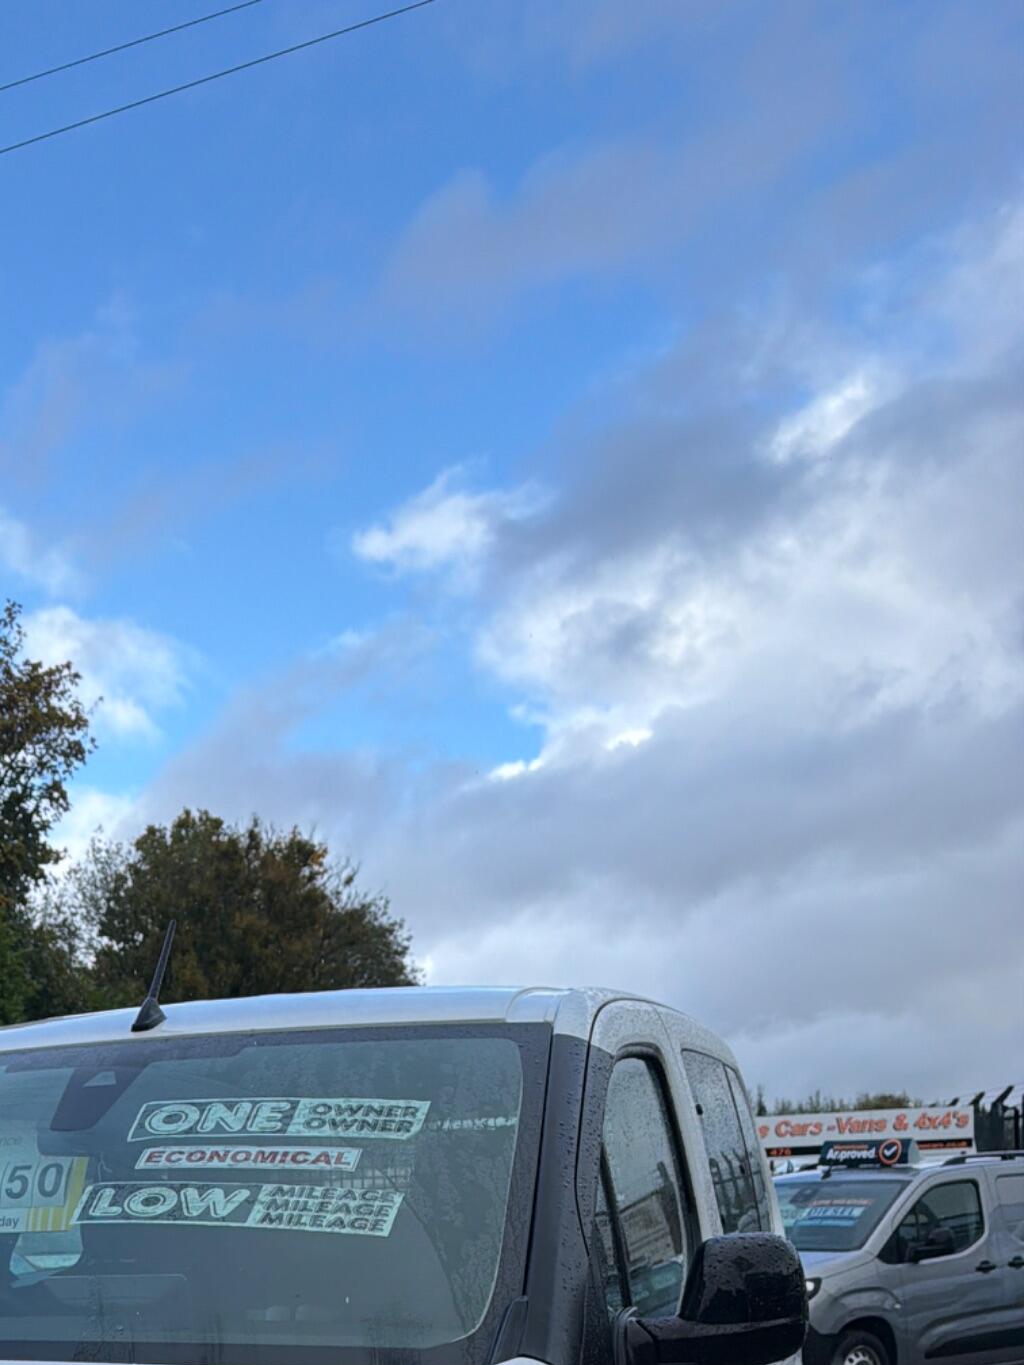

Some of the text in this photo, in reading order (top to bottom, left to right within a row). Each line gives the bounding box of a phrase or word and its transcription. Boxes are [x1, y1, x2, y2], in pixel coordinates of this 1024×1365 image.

[145, 1102, 291, 1135] ONE
[309, 1103, 419, 1118] OWNER
[303, 1117, 414, 1133] OWNER
[775, 1120, 822, 1137] Cars
[144, 1150, 352, 1166] ECONOMICAL
[90, 1187, 250, 1218] LOW
[264, 1200, 392, 1217] MILEAGE
[260, 1213, 387, 1232] MILEAGE
